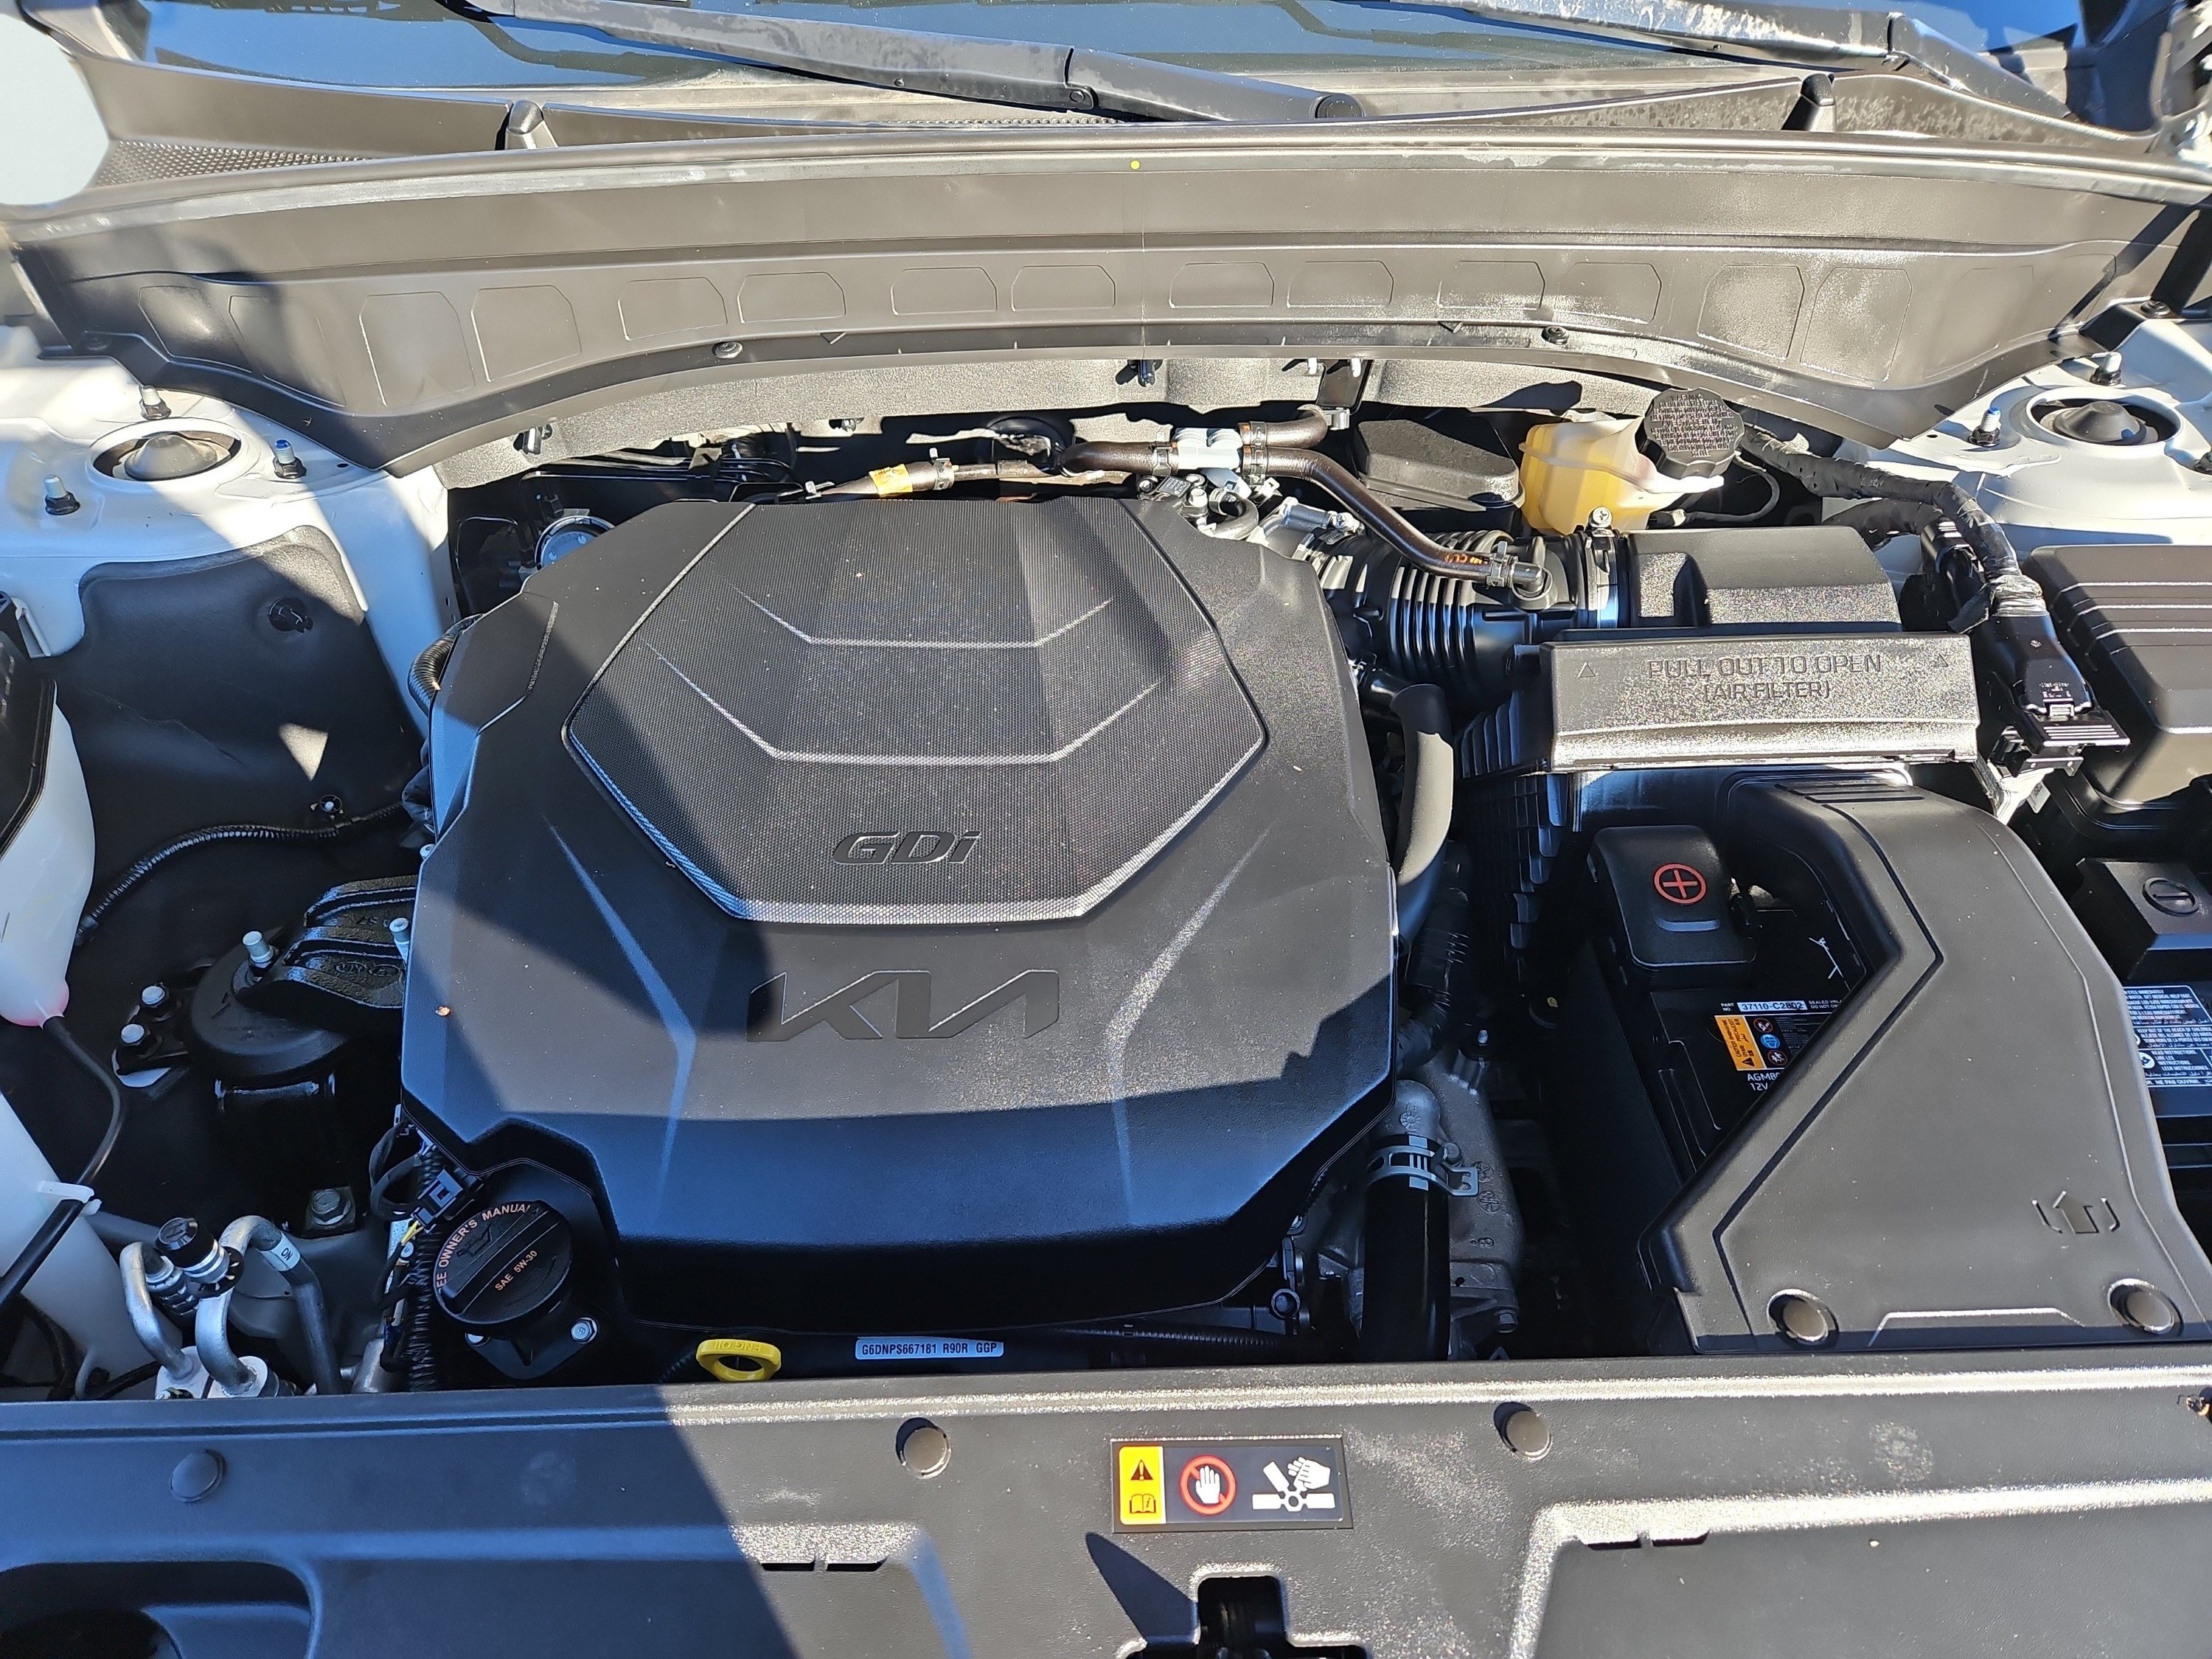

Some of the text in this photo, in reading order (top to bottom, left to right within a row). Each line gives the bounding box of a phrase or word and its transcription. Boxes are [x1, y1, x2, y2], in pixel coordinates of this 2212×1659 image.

[1648, 654, 1882, 678] PULL OUT TO OPEN
[1704, 680, 1831, 700] (AIR FILTER)
[832, 830, 982, 865] GDi
[746, 970, 1060, 1042] KIA
[1750, 1082, 1768, 1091] 12V
[439, 1220, 478, 1267] OWNER'S
[495, 1250, 538, 1291] SAE 5W-30
[862, 1342, 998, 1355] G6DNPS667181 R90R GGP
